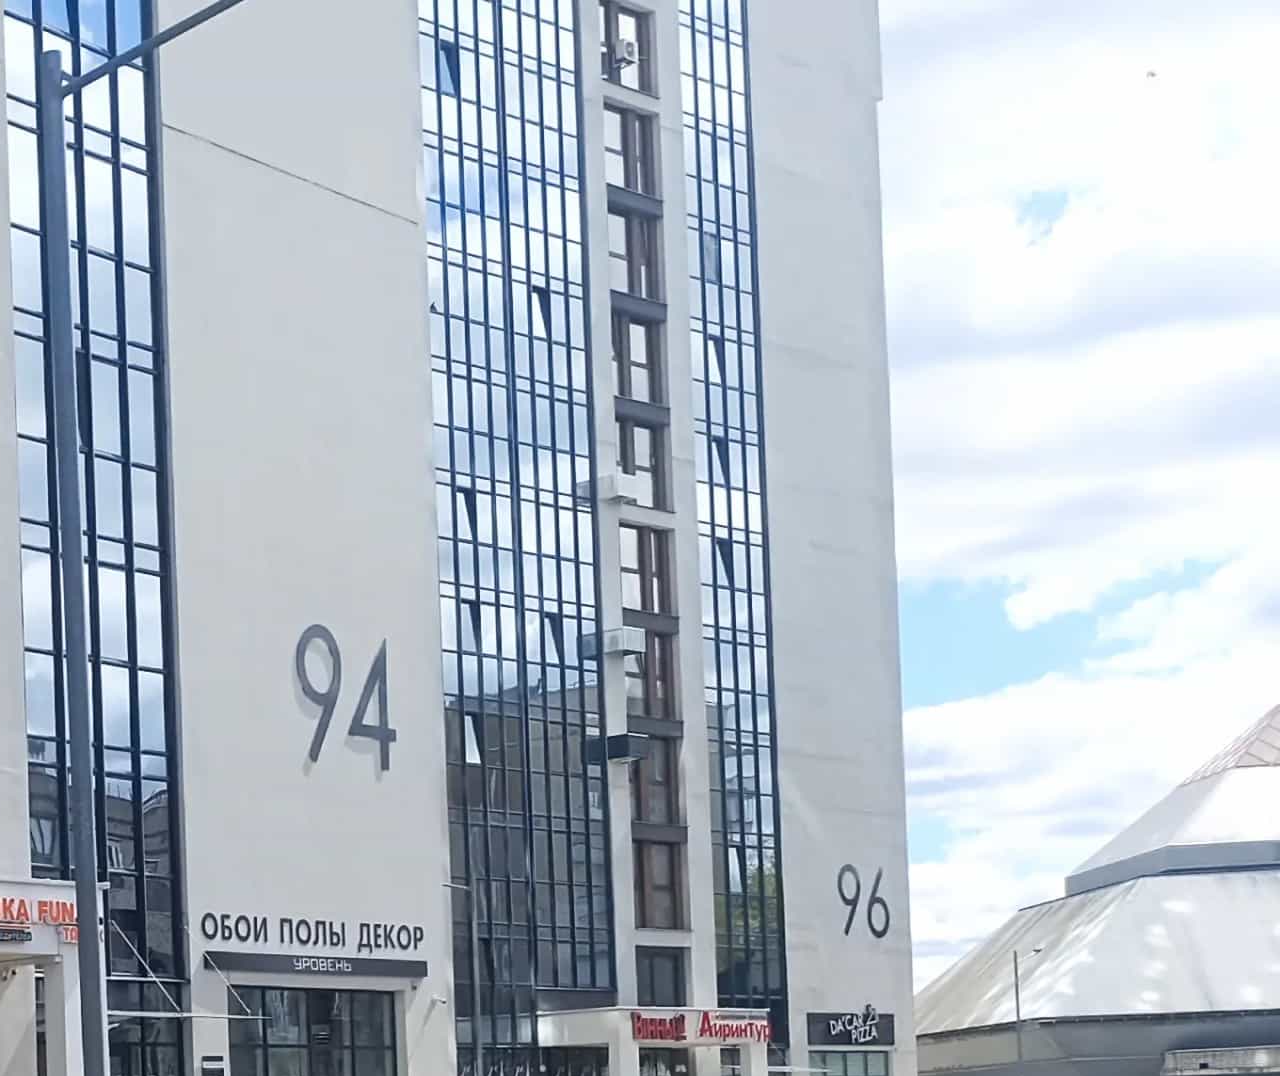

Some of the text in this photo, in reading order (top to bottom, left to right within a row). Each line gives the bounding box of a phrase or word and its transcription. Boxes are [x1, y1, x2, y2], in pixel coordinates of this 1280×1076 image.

[296, 624, 396, 771] 94
[837, 864, 890, 938] 96
[201, 912, 424, 953] ОБОИ ПОЛЫ ДЕКОР
[293, 958, 352, 972] УРОВЕНЬ
[851, 1025, 879, 1044] PIZZA
